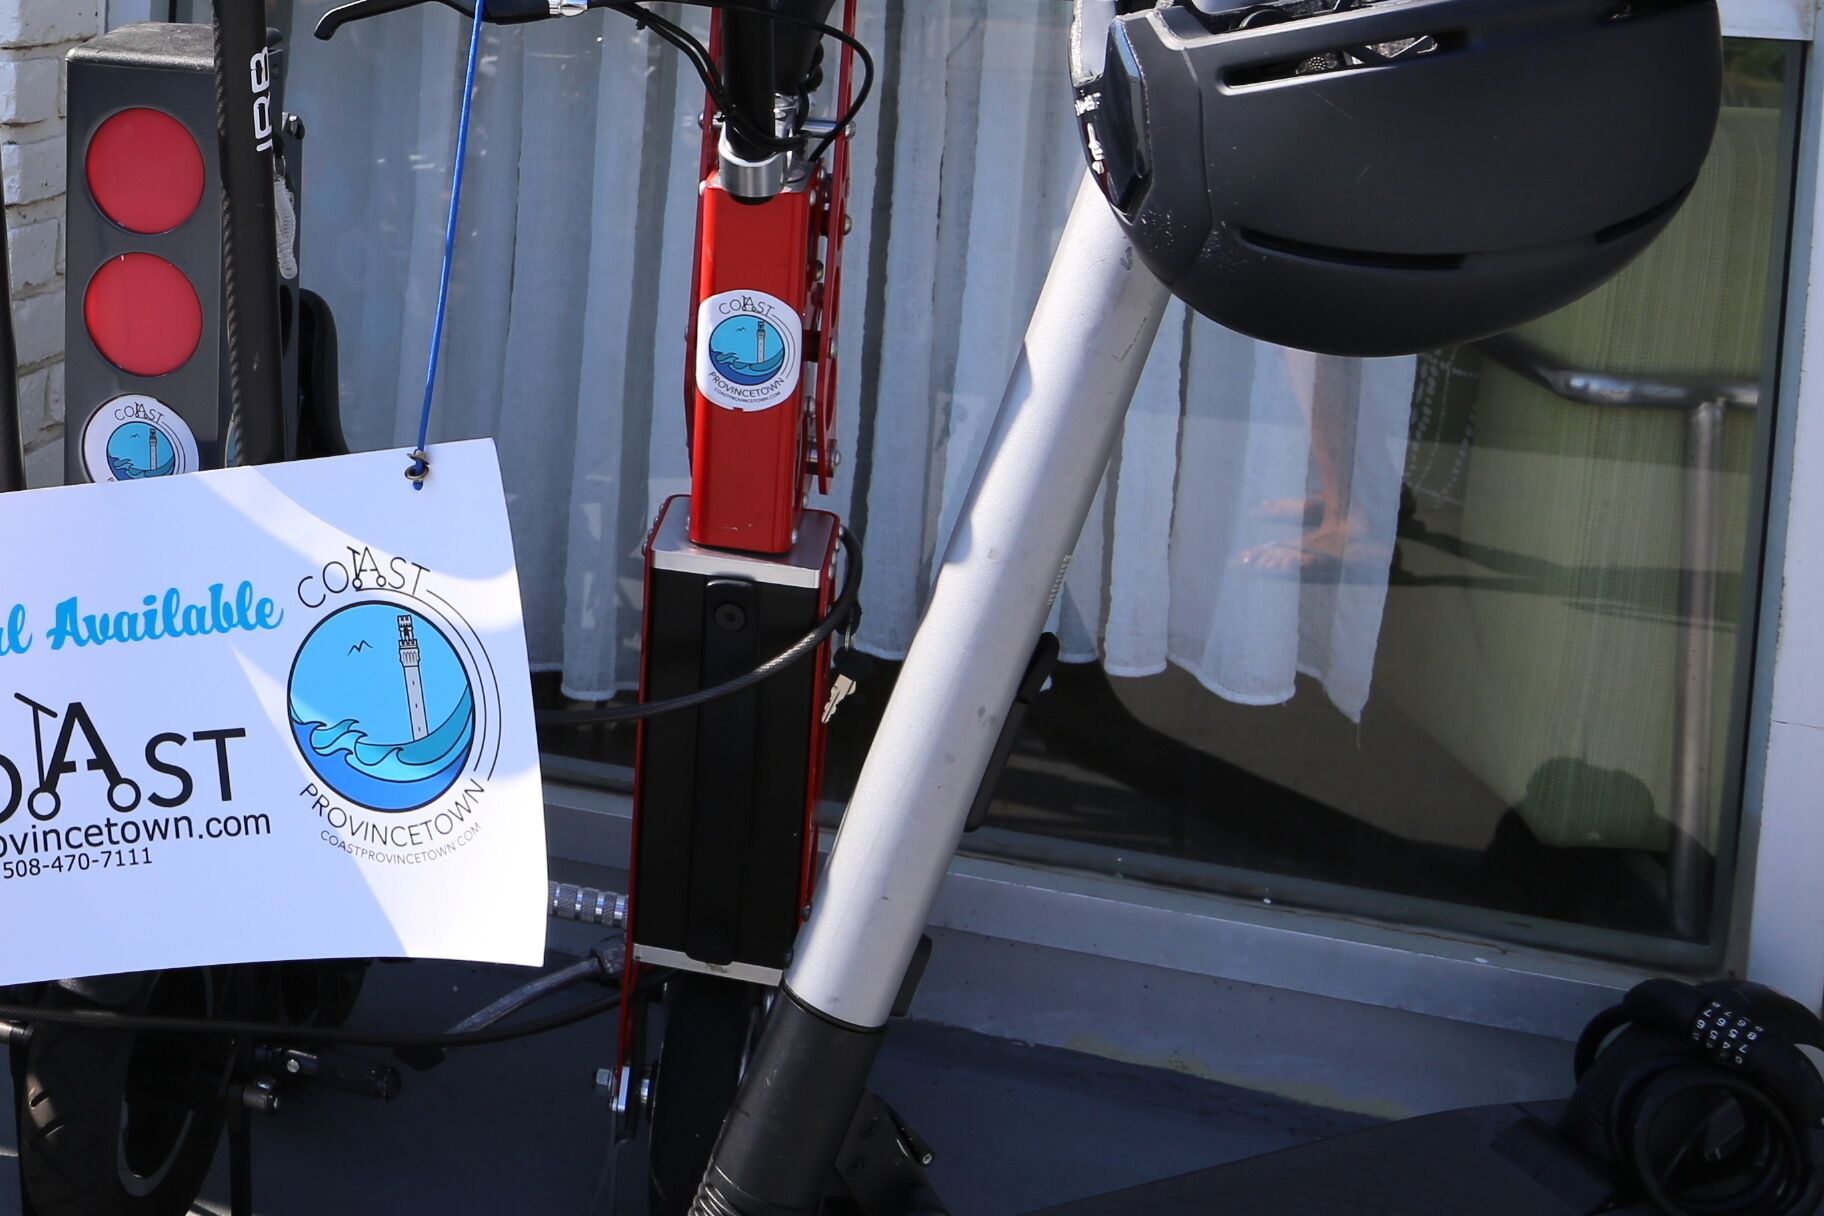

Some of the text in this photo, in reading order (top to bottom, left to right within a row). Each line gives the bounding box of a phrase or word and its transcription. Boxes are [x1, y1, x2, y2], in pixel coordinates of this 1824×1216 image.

[719, 295, 775, 317] COAST
[709, 371, 785, 398] PROVINCETOWN
[114, 402, 164, 424] COAST
[298, 546, 430, 608] COAST
[47, 580, 284, 650] Available
[299, 778, 485, 847] PROVINCETOWN
[320, 822, 482, 865] COASTPROVINCETOWN.COM
[2, 847, 153, 879] 508-470-7111
